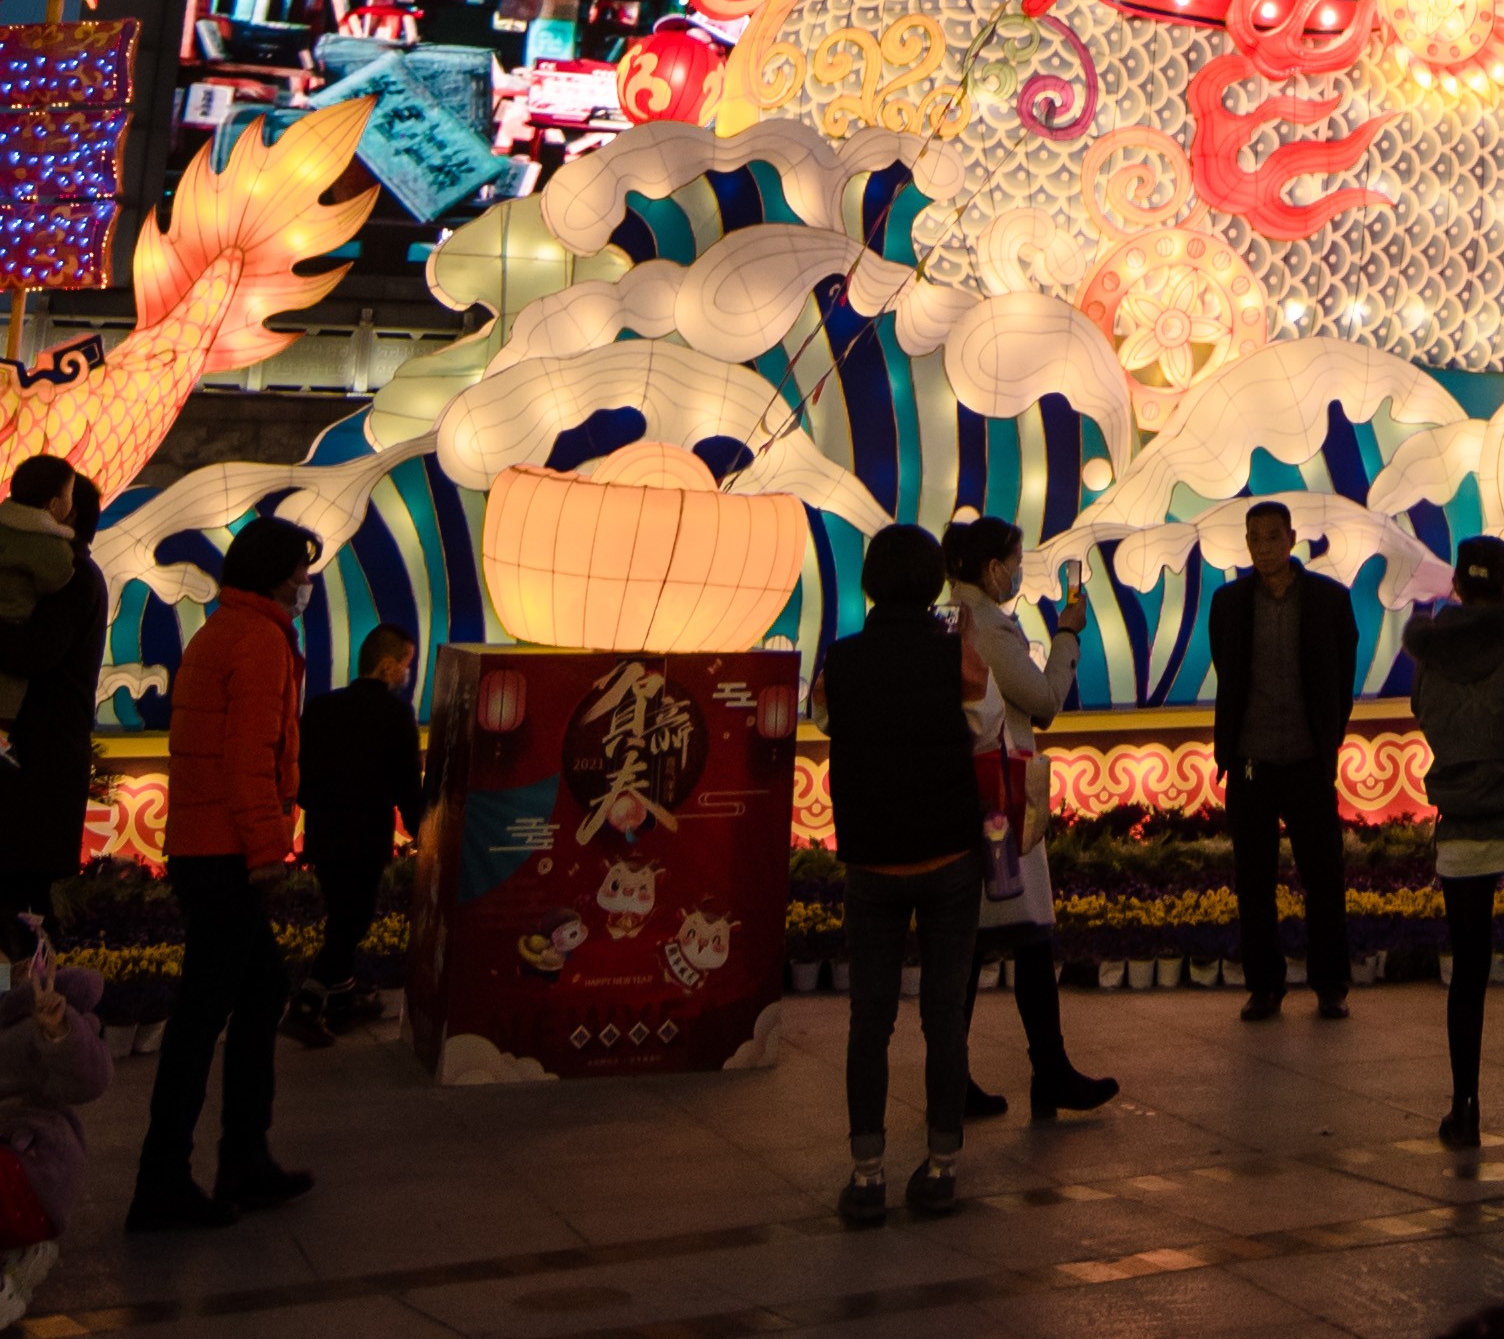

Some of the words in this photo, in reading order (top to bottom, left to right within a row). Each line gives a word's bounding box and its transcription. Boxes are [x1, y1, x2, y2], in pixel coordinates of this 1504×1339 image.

[573, 758, 604, 771] 2021
[585, 977, 611, 987] HAPPY
[613, 976, 631, 986] NEW
[632, 975, 652, 985] YEAR
